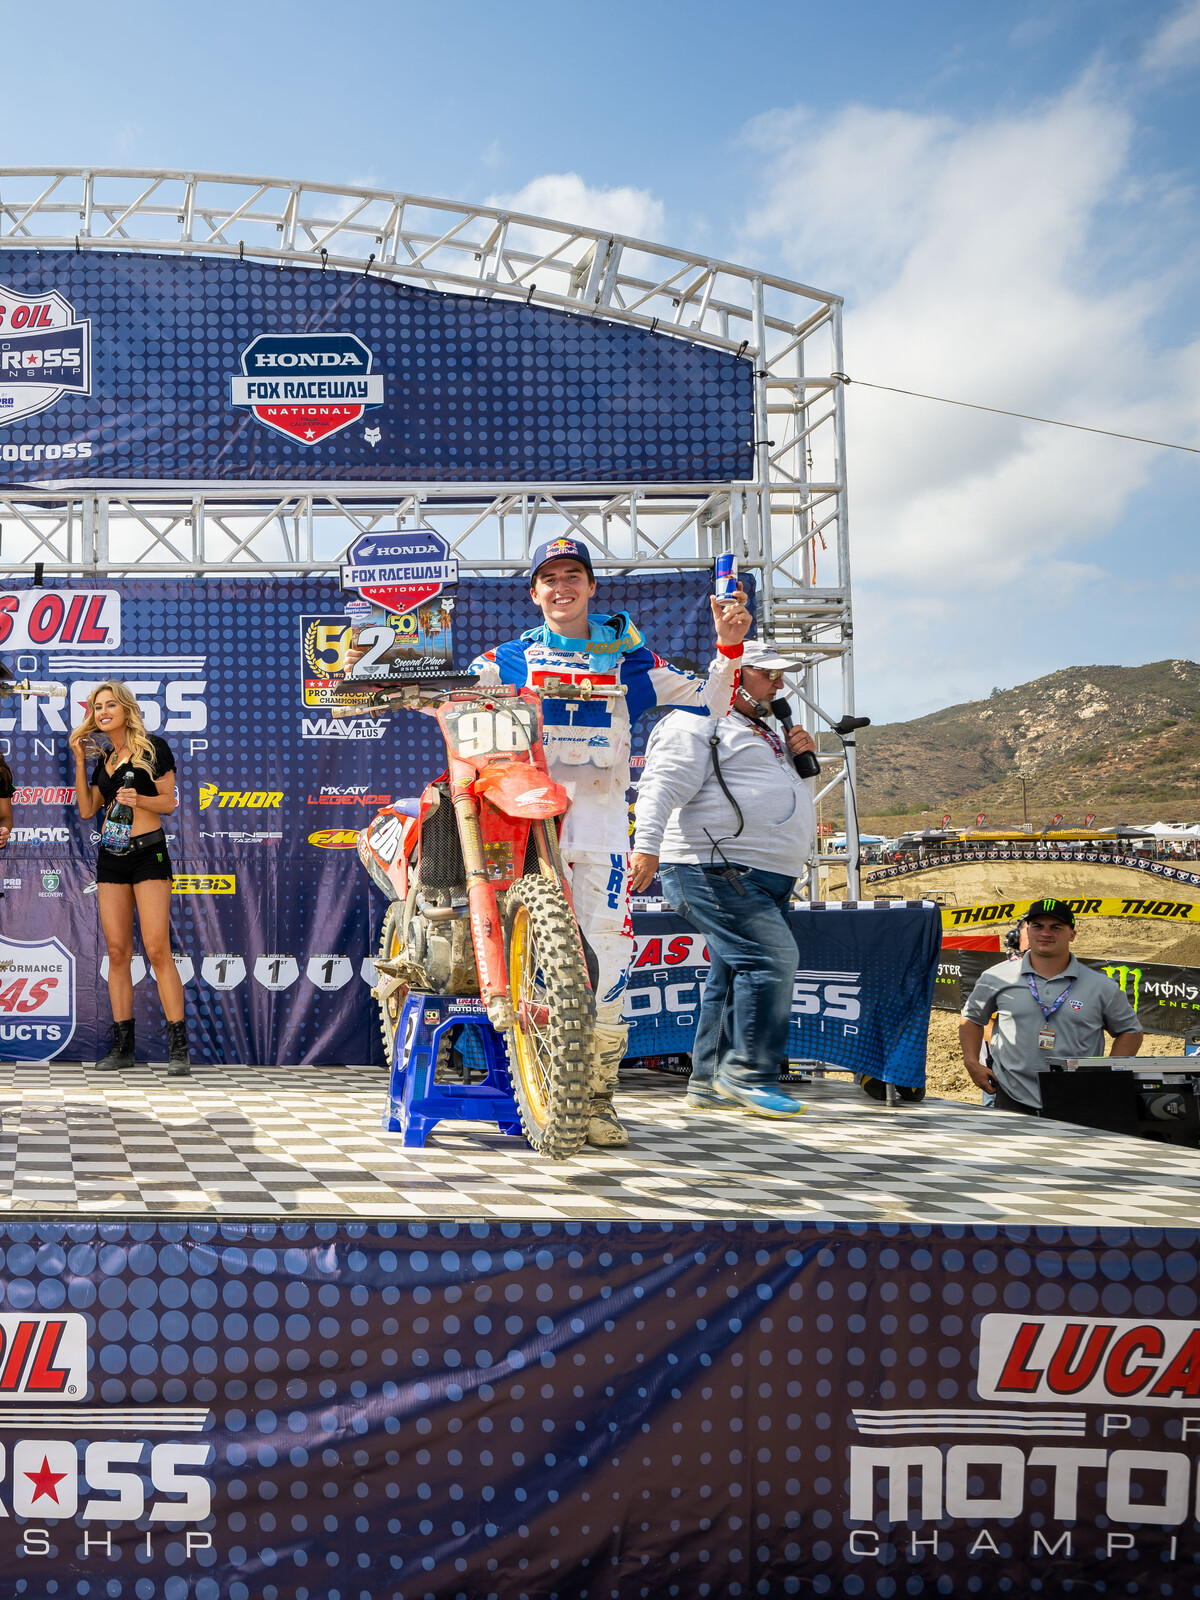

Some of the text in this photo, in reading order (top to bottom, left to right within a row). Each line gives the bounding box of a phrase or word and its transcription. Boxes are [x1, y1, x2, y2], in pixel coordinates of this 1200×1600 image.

[11, 304, 53, 328] OIL
[254, 352, 363, 367] HONDA
[247, 381, 368, 399] FOX RACEWAY
[267, 407, 351, 415] NATIONAL
[376, 545, 440, 556] HONDA
[351, 569, 376, 583] FOX
[378, 566, 442, 581] RACEWAY
[369, 585, 433, 594] NATIONAL
[28, 595, 112, 644] OIL
[390, 614, 413, 633] 50
[352, 626, 396, 677] 2
[584, 636, 635, 655] 100%
[393, 657, 447, 668] Second Place
[308, 689, 330, 697] PRO
[319, 697, 370, 705] CHAMPIONSHI
[355, 729, 379, 738] PLUS
[457, 709, 531, 758] 96
[319, 786, 369, 795] MX-ATV
[218, 791, 285, 808] THOR
[307, 795, 392, 807] LEGENDS
[7, 827, 70, 842] STACYC
[47, 880, 55, 889] 2
[951, 903, 1016, 925] THOR
[1120, 899, 1194, 919] THOR
[471, 913, 490, 988] DUNLOP
[850, 1445, 1200, 1526] MOTO
